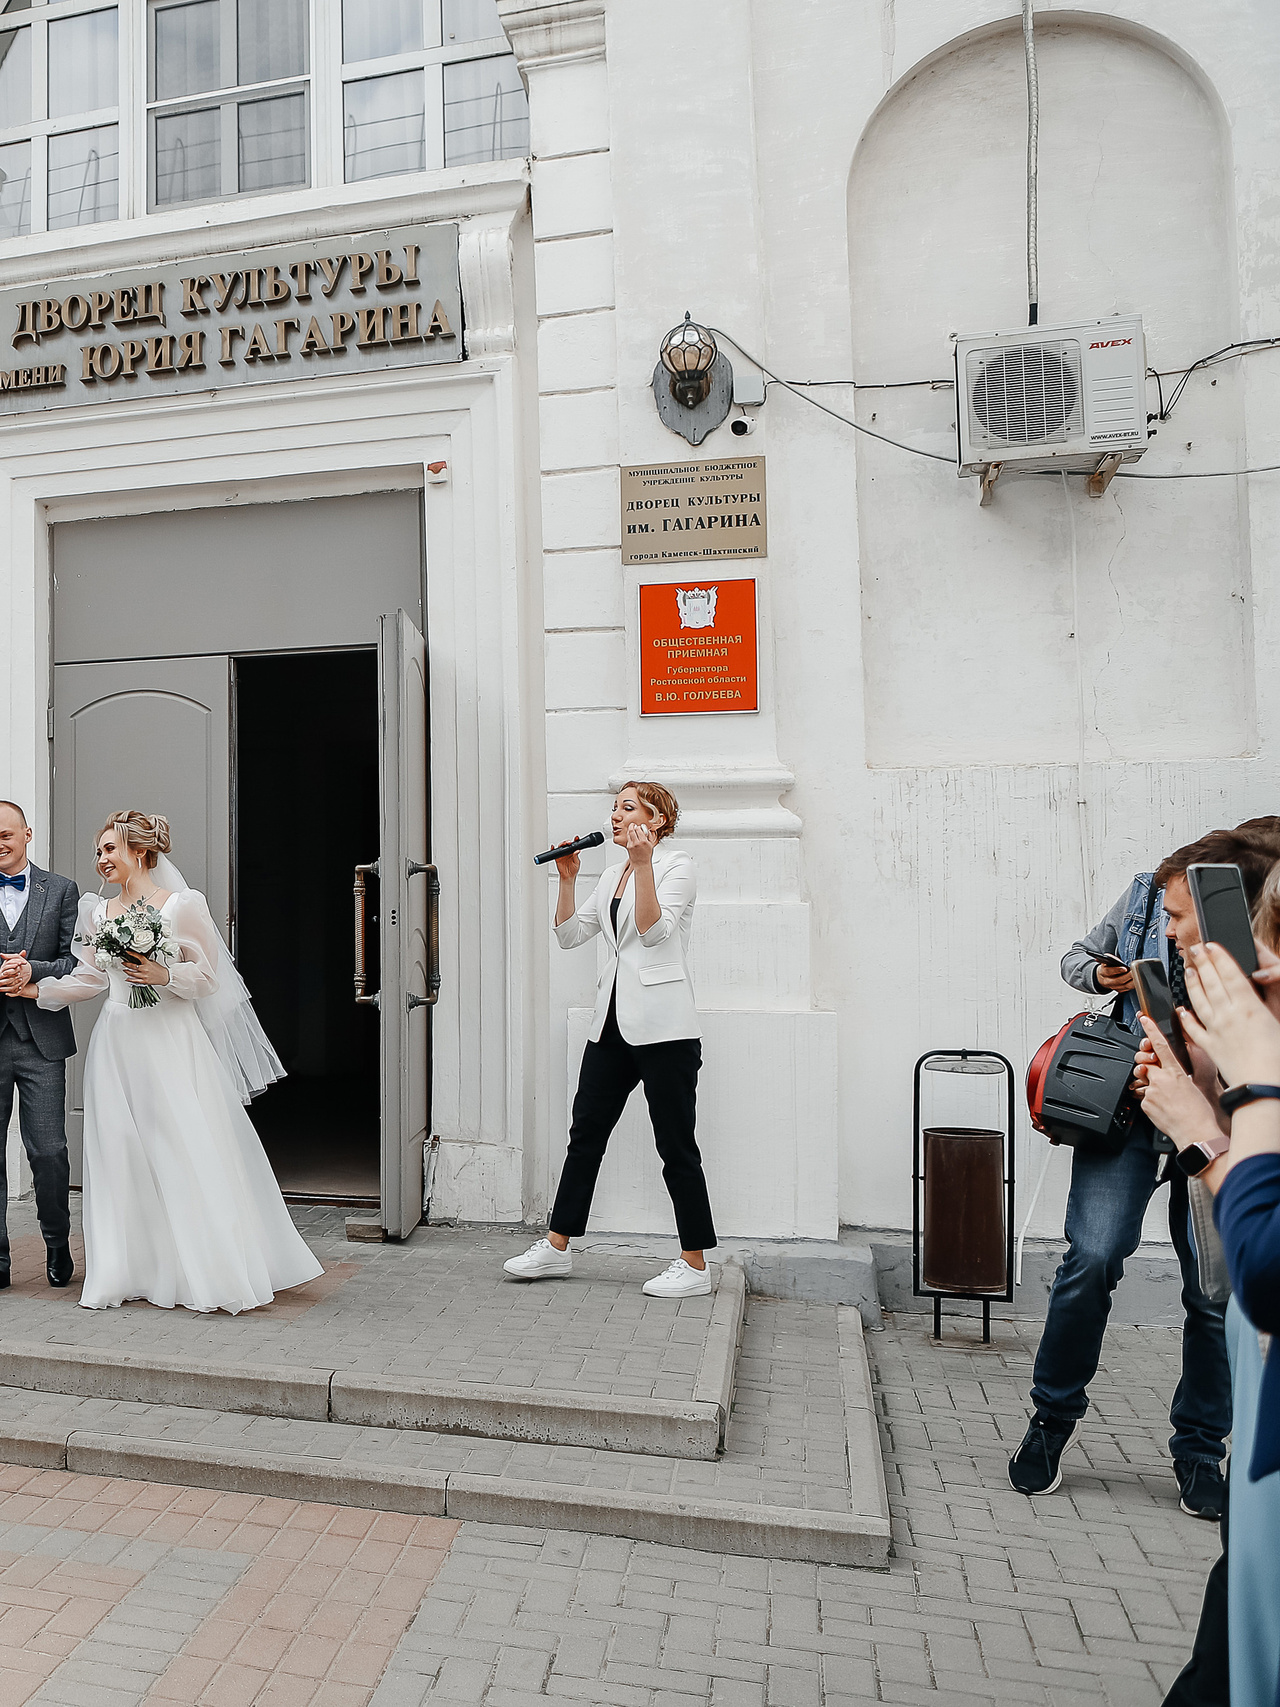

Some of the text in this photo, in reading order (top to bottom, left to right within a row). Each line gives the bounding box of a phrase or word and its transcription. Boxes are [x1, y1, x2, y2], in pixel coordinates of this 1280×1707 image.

[11, 244, 421, 348] ДВОРЕЦ КУЛЬТУРЫ
[79, 330, 206, 384] ЮРИЯ
[218, 298, 456, 366] ГАГАРИНА
[1089, 337, 1133, 350] AVEX
[628, 462, 758, 477] МУНИЦИПАЛЬНОЕ БЮДЖЕТНОЕ
[642, 473, 744, 487] УЧРЕЖДЕНИЕ КУЛЬТУРЫ
[626, 493, 761, 512] ДВОРЕЦ КУЛЬТУРЫ
[662, 512, 761, 532] ГАГАРИНА
[629, 552, 659, 561] города
[653, 635, 742, 648] ОБЩЕСТВЕННАЯ
[667, 647, 728, 659] ПРИЕМНАЯ
[667, 665, 729, 675] Губернатора
[650, 675, 747, 686] Ростовской области
[655, 690, 742, 702] В.Ю. ГОЛУБЕВА
